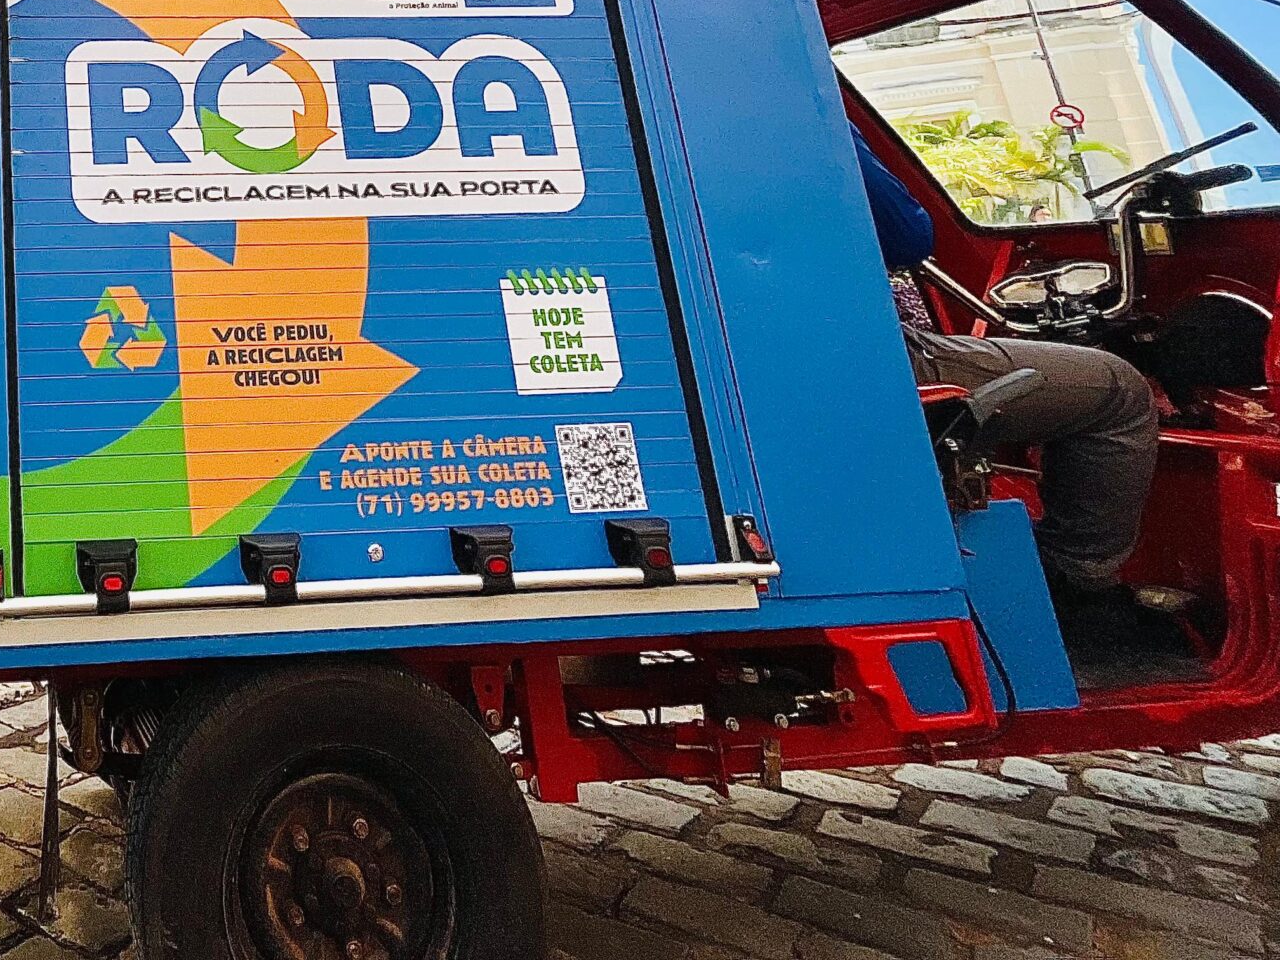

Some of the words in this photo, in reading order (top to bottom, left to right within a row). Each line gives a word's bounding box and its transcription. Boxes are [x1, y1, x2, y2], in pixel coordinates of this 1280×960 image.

[86, 29, 558, 174] RODA
[101, 186, 126, 205] A
[132, 183, 331, 204] RECICLAGEM
[338, 181, 384, 199] NA
[391, 179, 451, 198] SUA
[460, 179, 561, 197] PORTA
[532, 307, 585, 327] HOJE
[211, 322, 267, 343] VOCÊ
[273, 324, 333, 342] PEDIU,
[540, 331, 584, 349] TEM
[207, 349, 220, 366] A
[225, 346, 343, 365] RECICLAGEM
[529, 353, 604, 374] COLETA
[234, 369, 320, 387] CHEGOU!
[340, 439, 433, 463] APONTE
[442, 439, 456, 459] A
[463, 434, 547, 458] CÂMERA
[319, 471, 332, 490] E
[341, 468, 423, 489] AGENDE
[430, 465, 471, 485] SUA
[478, 461, 552, 482] COLETA
[356, 491, 403, 519] (71)
[410, 488, 555, 513] 99957-8803
